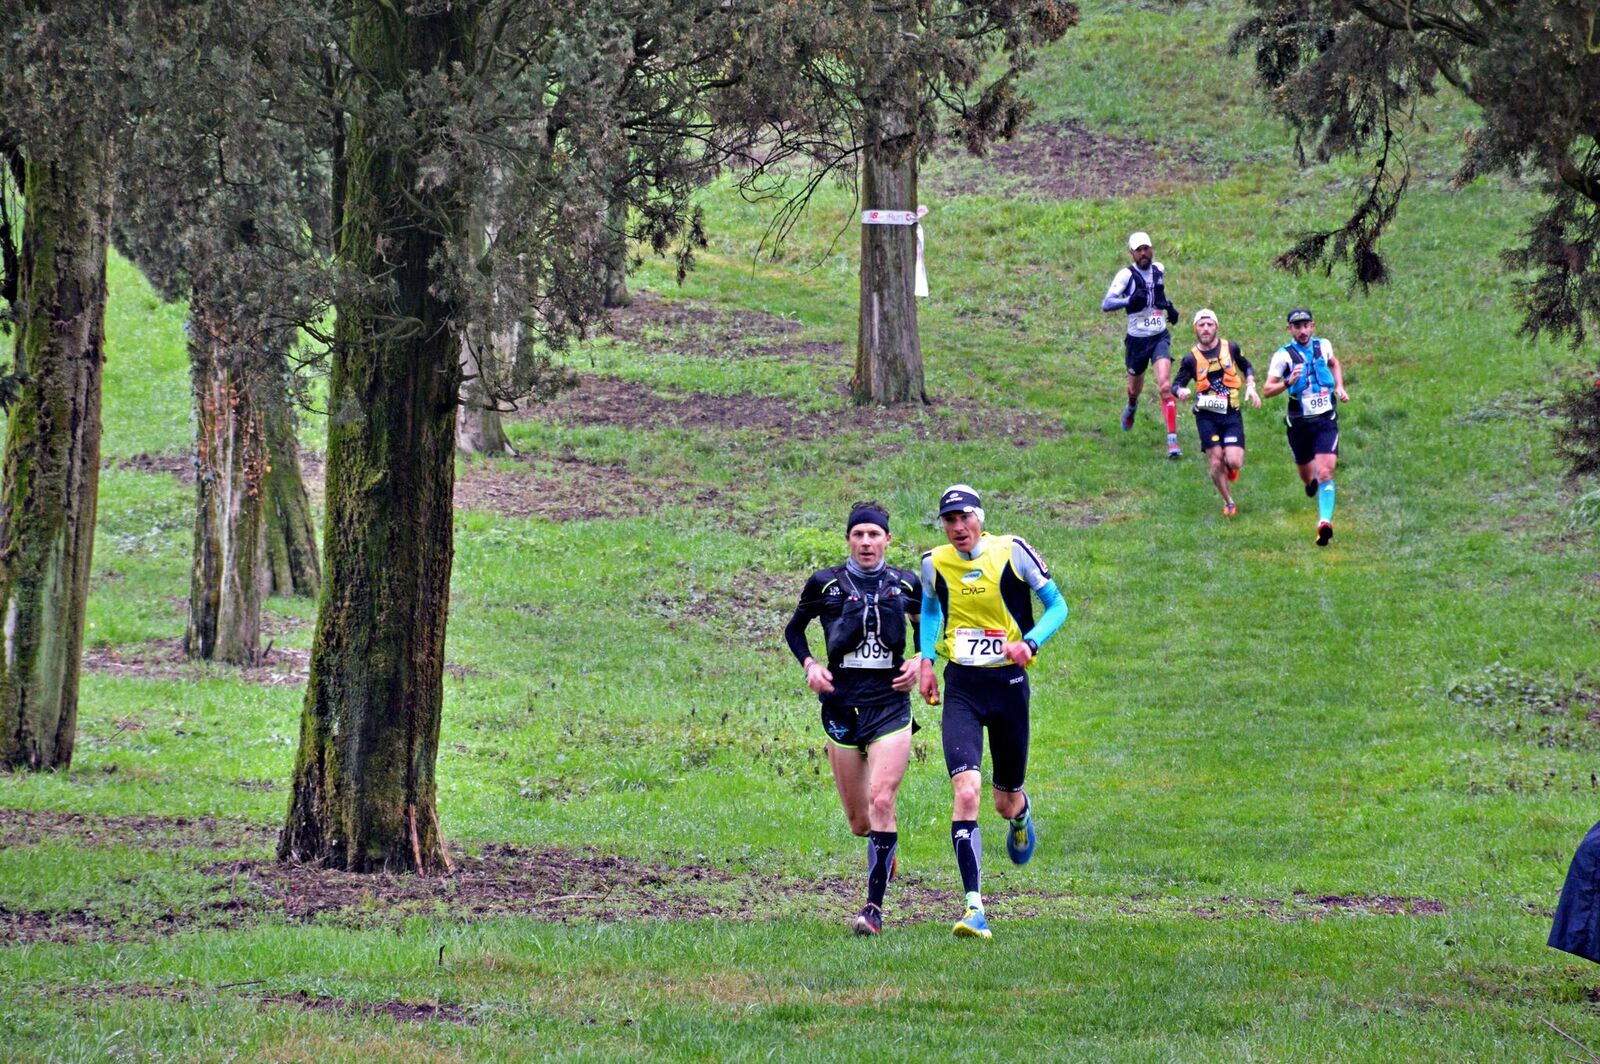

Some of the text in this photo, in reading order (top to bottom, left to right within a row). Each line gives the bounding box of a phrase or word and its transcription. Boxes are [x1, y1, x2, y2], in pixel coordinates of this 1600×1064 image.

[1144, 317, 1162, 327] 846
[1204, 400, 1225, 409] 1066
[1310, 396, 1328, 409] 985
[967, 638, 1004, 656] 720
